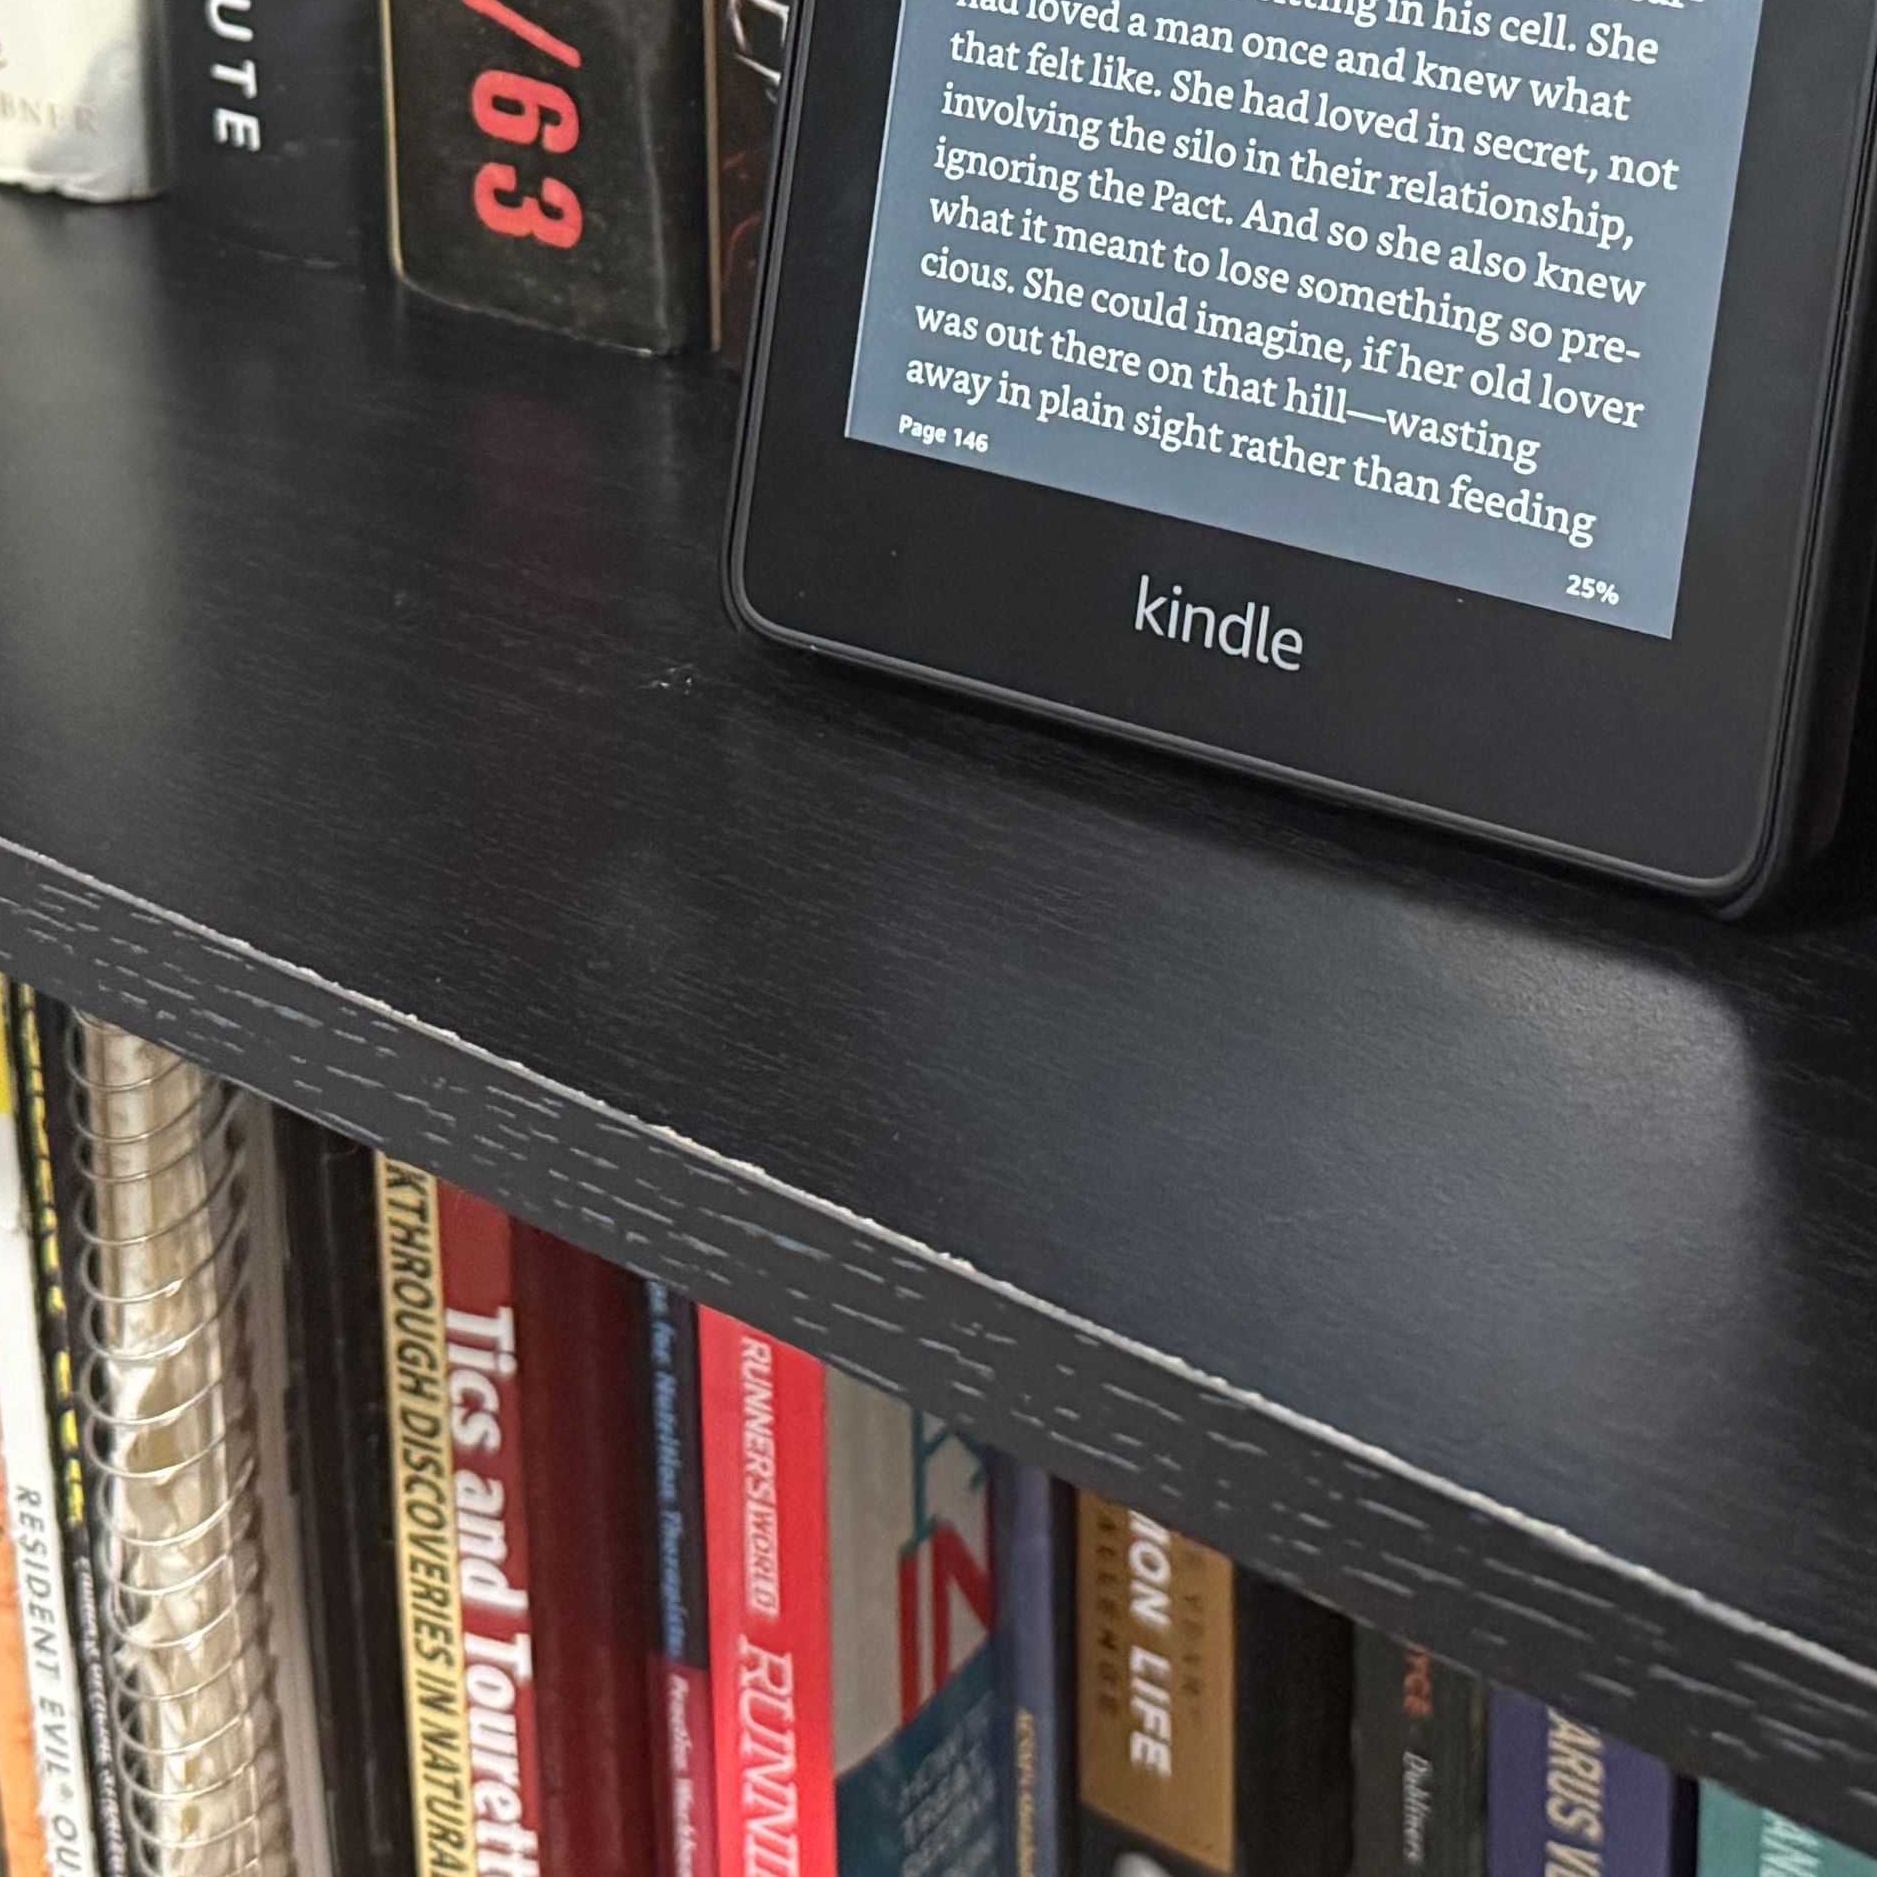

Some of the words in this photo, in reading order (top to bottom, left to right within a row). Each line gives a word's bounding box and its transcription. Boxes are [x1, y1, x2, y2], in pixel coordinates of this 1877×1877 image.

[1126, 11, 1148, 39] a
[1152, 16, 1235, 54] man
[1240, 31, 1329, 70] once
[1334, 46, 1407, 84] and
[1411, 49, 1523, 103] knew
[1528, 74, 1633, 122] what
[933, 134, 1083, 205] ignoring
[1087, 166, 1146, 208] the
[1149, 178, 1234, 226] Pact.
[1239, 198, 1320, 243] And
[1325, 220, 1370, 253] so
[1375, 223, 1442, 267] she
[1447, 237, 1528, 284] also
[1532, 250, 1647, 307] knew
[914, 304, 980, 342] was
[984, 321, 1045, 357] out
[1049, 327, 1142, 378] there
[1146, 357, 1195, 391] on
[1200, 360, 1279, 409] that
[897, 413, 948, 446] Page
[952, 426, 990, 454] 146
[905, 358, 994, 407] away
[995, 369, 1032, 411] in
[1035, 383, 1126, 433] plain
[1131, 403, 1225, 454] sight
[1227, 432, 1348, 482] rather
[1351, 453, 1442, 506] than
[1447, 472, 1598, 550] feeding
[1134, 575, 1304, 674] kindle
[1564, 573, 1621, 606] 25%
[446, 1306, 519, 1455] Tics
[400, 1405, 456, 1668] DISCOVERIES
[455, 1467, 530, 1616] and
[746, 1507, 780, 1616] WORLD
[14, 1485, 61, 1687] RESIDENT
[54, 1813, 85, 1877] OU
[416, 1669, 458, 1717] IN
[1128, 1644, 1173, 1780] LIFE
[421, 1718, 469, 1877] NATURA
[738, 1633, 800, 1877] RUNNI
